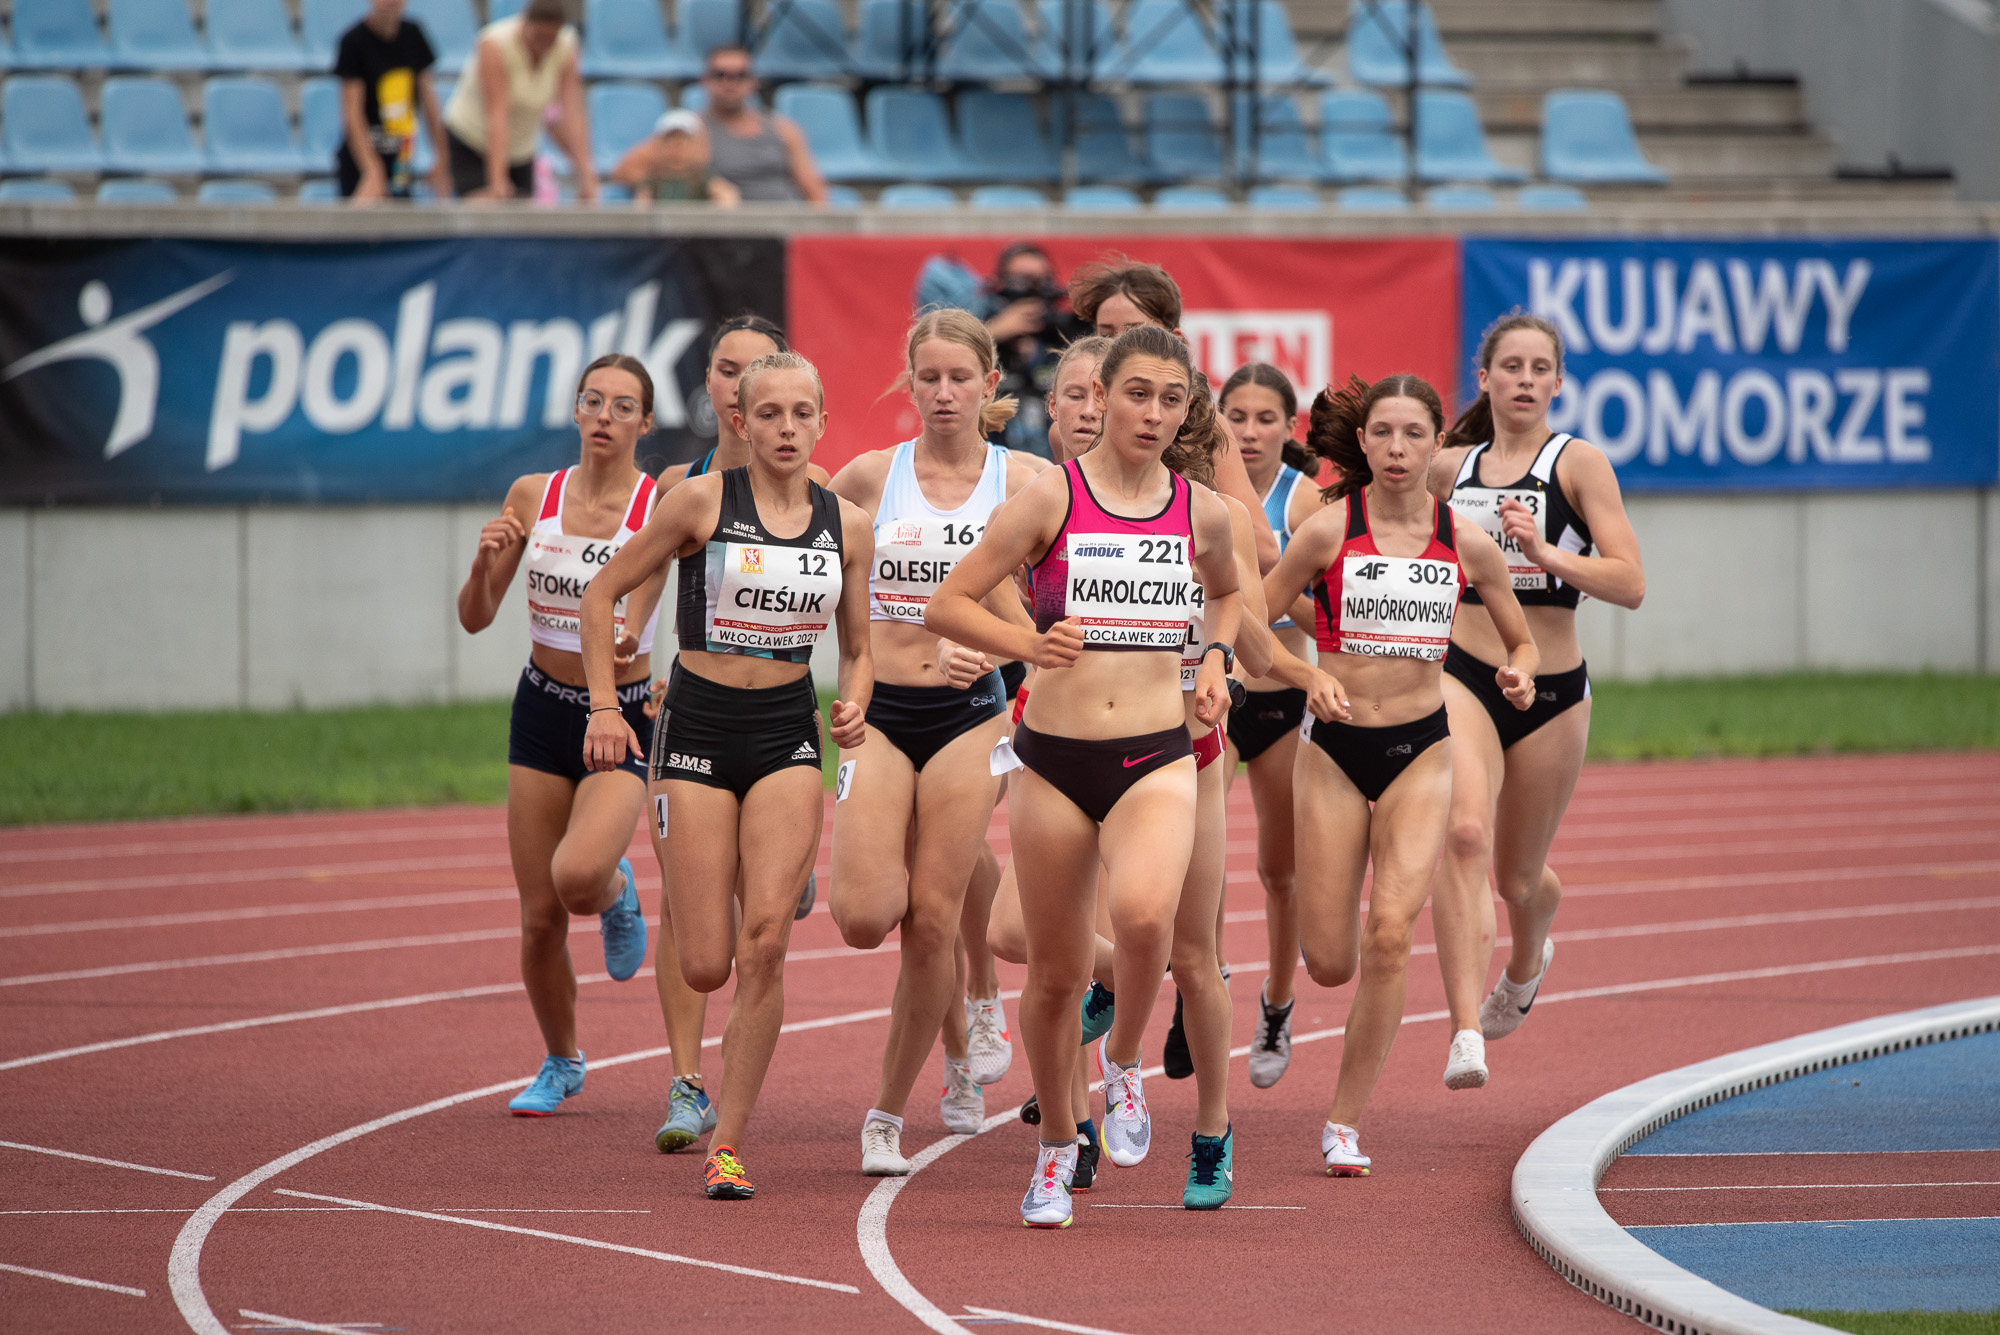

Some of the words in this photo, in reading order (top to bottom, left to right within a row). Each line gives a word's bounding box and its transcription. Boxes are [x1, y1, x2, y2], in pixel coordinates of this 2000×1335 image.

[1528, 257, 1874, 355] KUJAWY
[1198, 330, 1309, 391] LEN
[733, 521, 756, 534] SMS
[892, 526, 921, 539] Anwil
[582, 543, 621, 565] 66
[812, 540, 838, 549] adidas
[1074, 547, 1126, 558] 4MOVE
[1138, 540, 1184, 565] 221
[798, 553, 828, 576] 12
[1355, 562, 1389, 580] 4F
[1408, 563, 1453, 585] 302
[529, 570, 590, 599] STOKŁ
[1072, 578, 1188, 606] KAROLCZUK
[1514, 577, 1540, 588] 2021
[735, 586, 826, 613] CIEŚLIK
[1346, 594, 1452, 624] NAPIÓRKOWSKA
[880, 603, 925, 617] WŁOCŁ
[1102, 619, 1151, 627] MISTRZOSTWA
[720, 630, 794, 646] WŁOCŁAWEK
[796, 633, 818, 644] 2021
[1081, 629, 1154, 643] ŁOCŁAWEK
[1158, 632, 1181, 644] 2021
[1345, 642, 1422, 658] WŁOCŁAWEK
[617, 680, 652, 703] NIK
[669, 752, 712, 771] SMS
[791, 752, 817, 760] adidas
[837, 765, 848, 800] 8
[656, 798, 665, 836] 4
